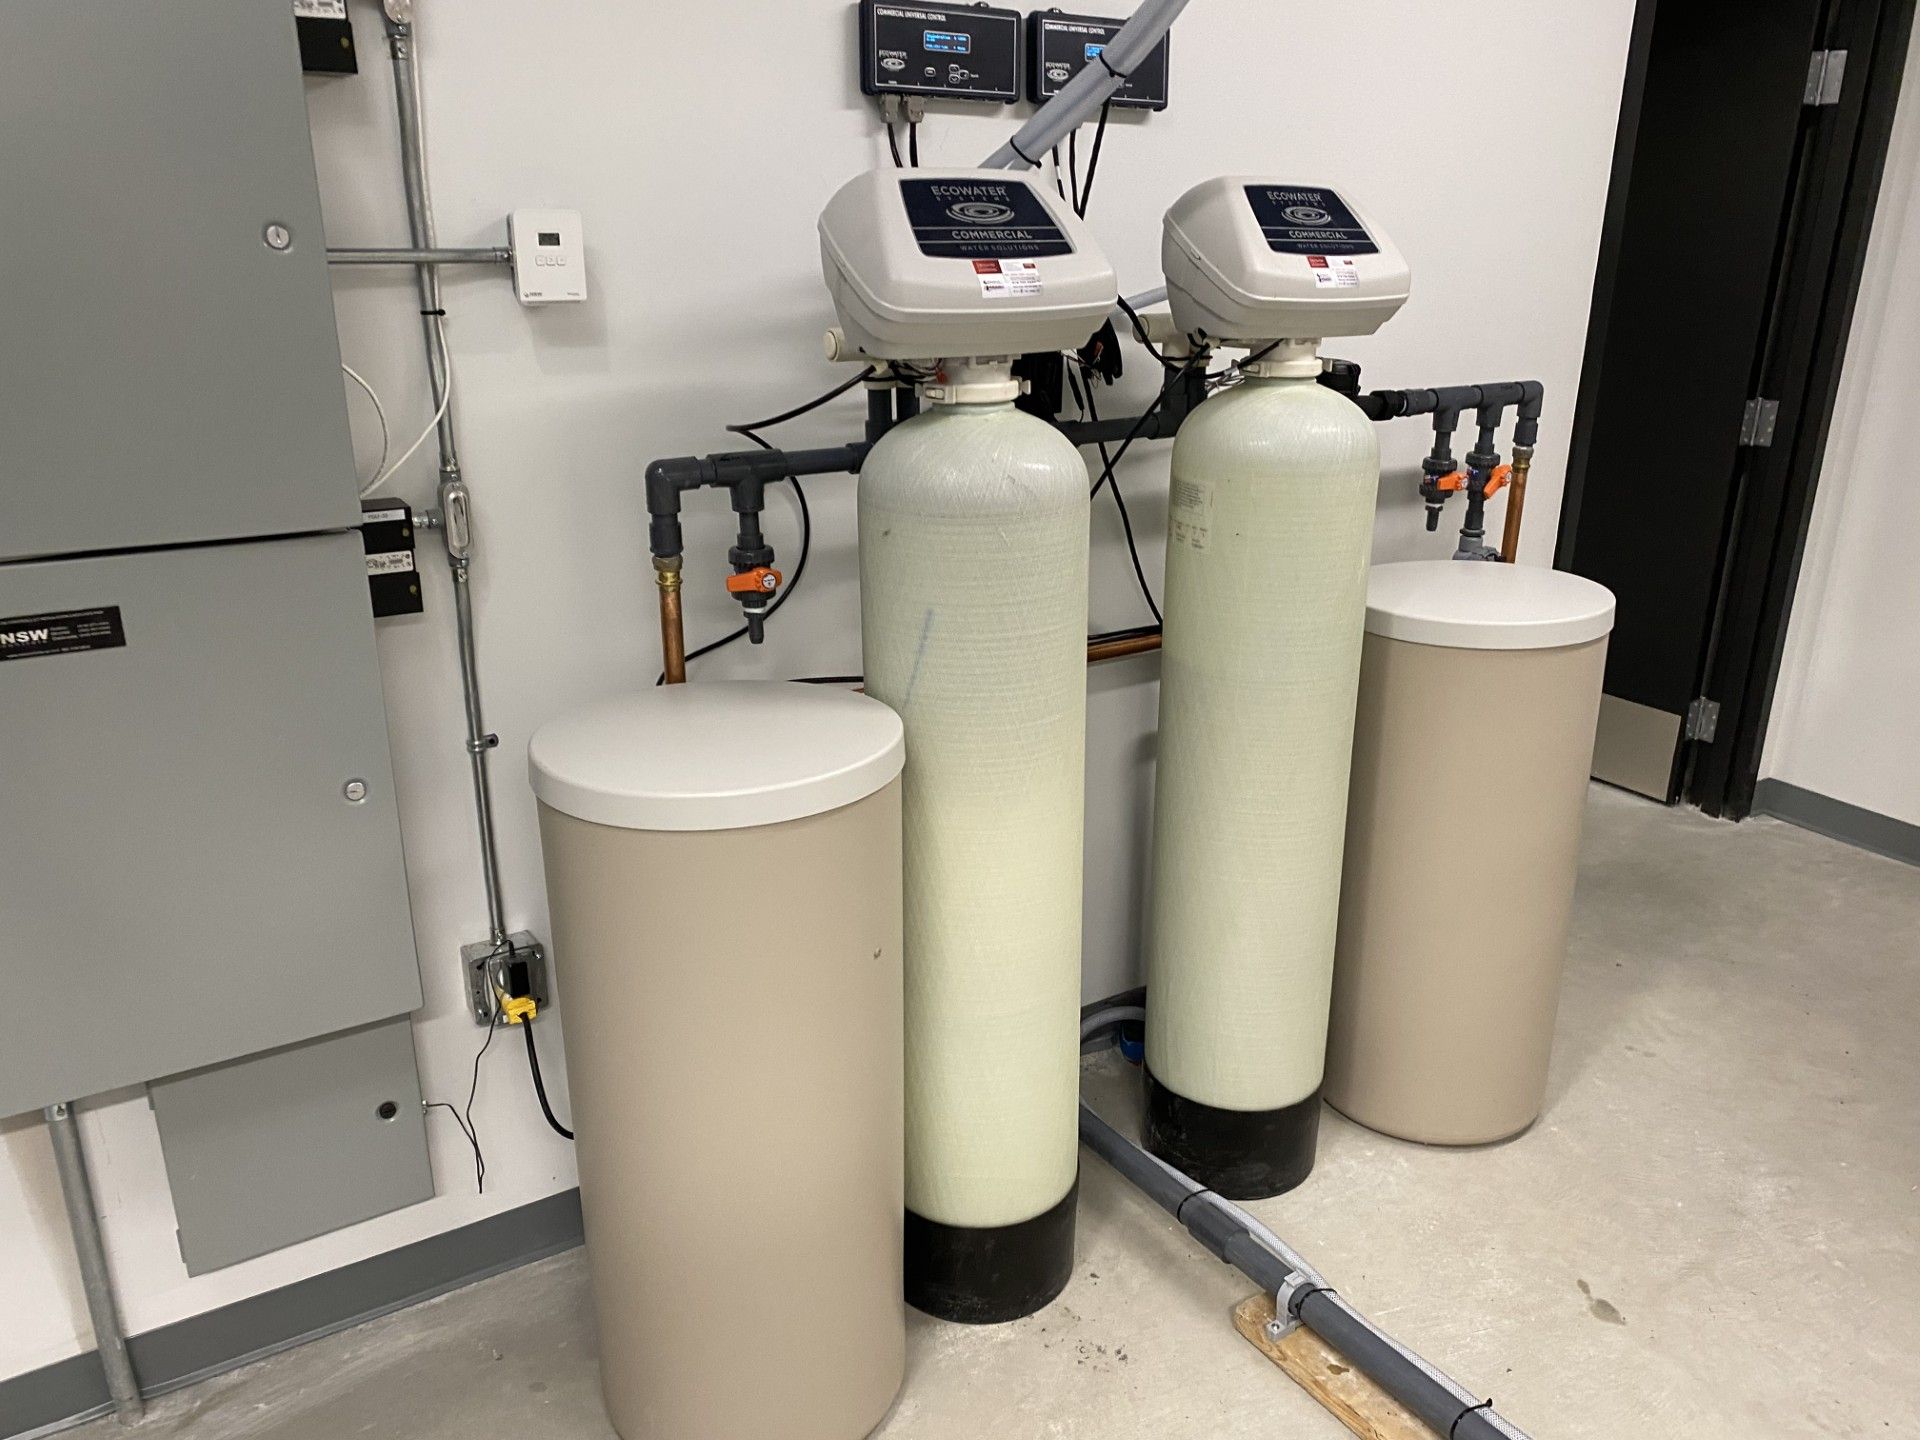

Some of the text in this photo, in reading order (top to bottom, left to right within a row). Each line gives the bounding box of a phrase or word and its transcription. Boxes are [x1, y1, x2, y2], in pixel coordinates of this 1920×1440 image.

[877, 8, 947, 21] COMMERCIAL UNIVERSAL CONTROL
[931, 186, 1006, 196] ECOWATER
[1266, 191, 1322, 201] ECOWATER
[952, 231, 1032, 239] COMMERCIAL
[1288, 230, 1348, 239] COMMERCIAL
[0, 628, 48, 644] NSW
